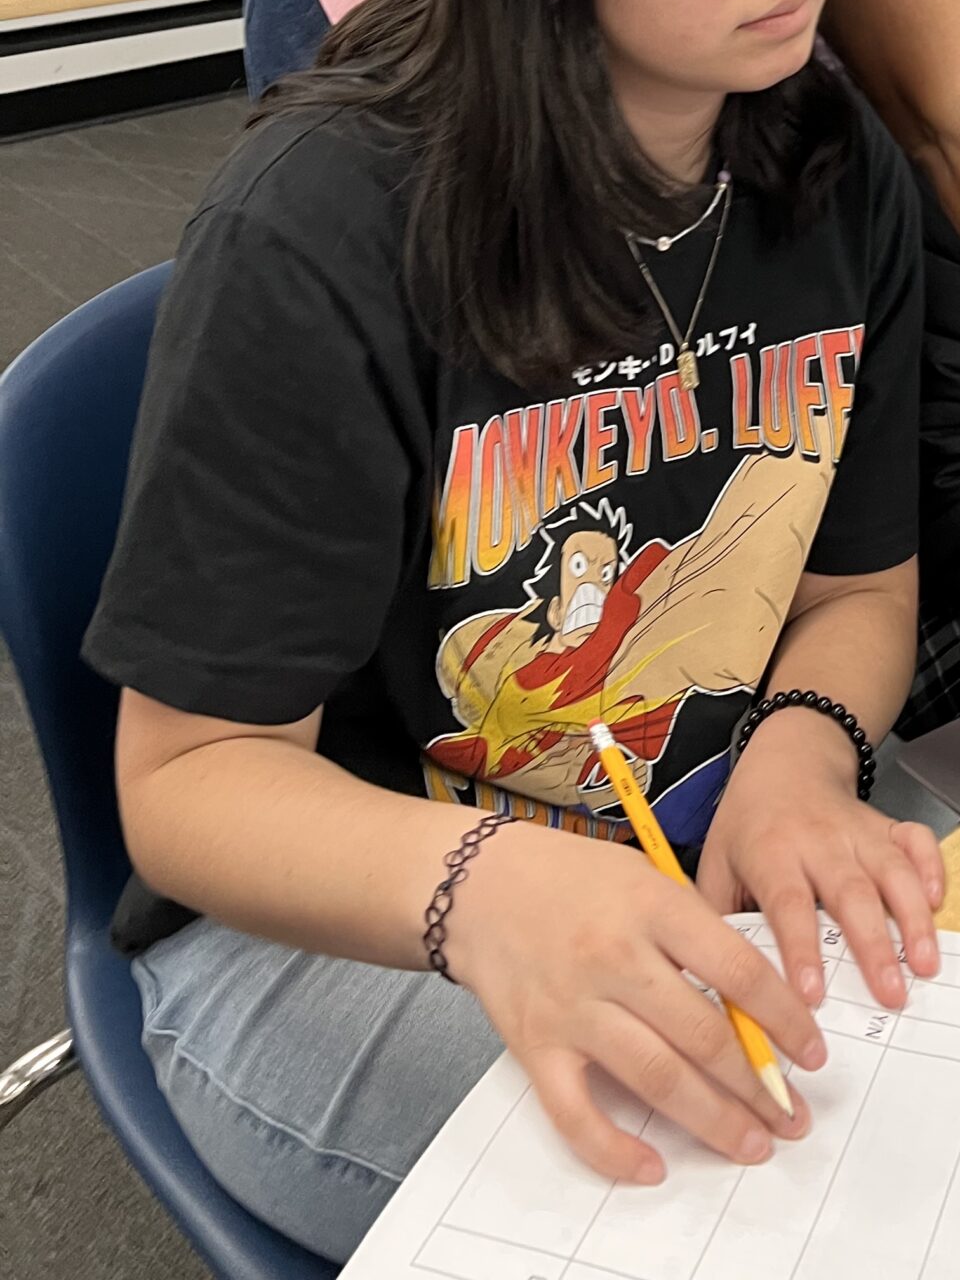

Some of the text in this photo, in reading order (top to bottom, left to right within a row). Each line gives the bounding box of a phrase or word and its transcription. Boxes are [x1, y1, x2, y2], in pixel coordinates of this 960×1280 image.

[729, 323, 866, 463] LUFF
[823, 928, 842, 945] 30
[864, 1014, 889, 1040] Y/N
